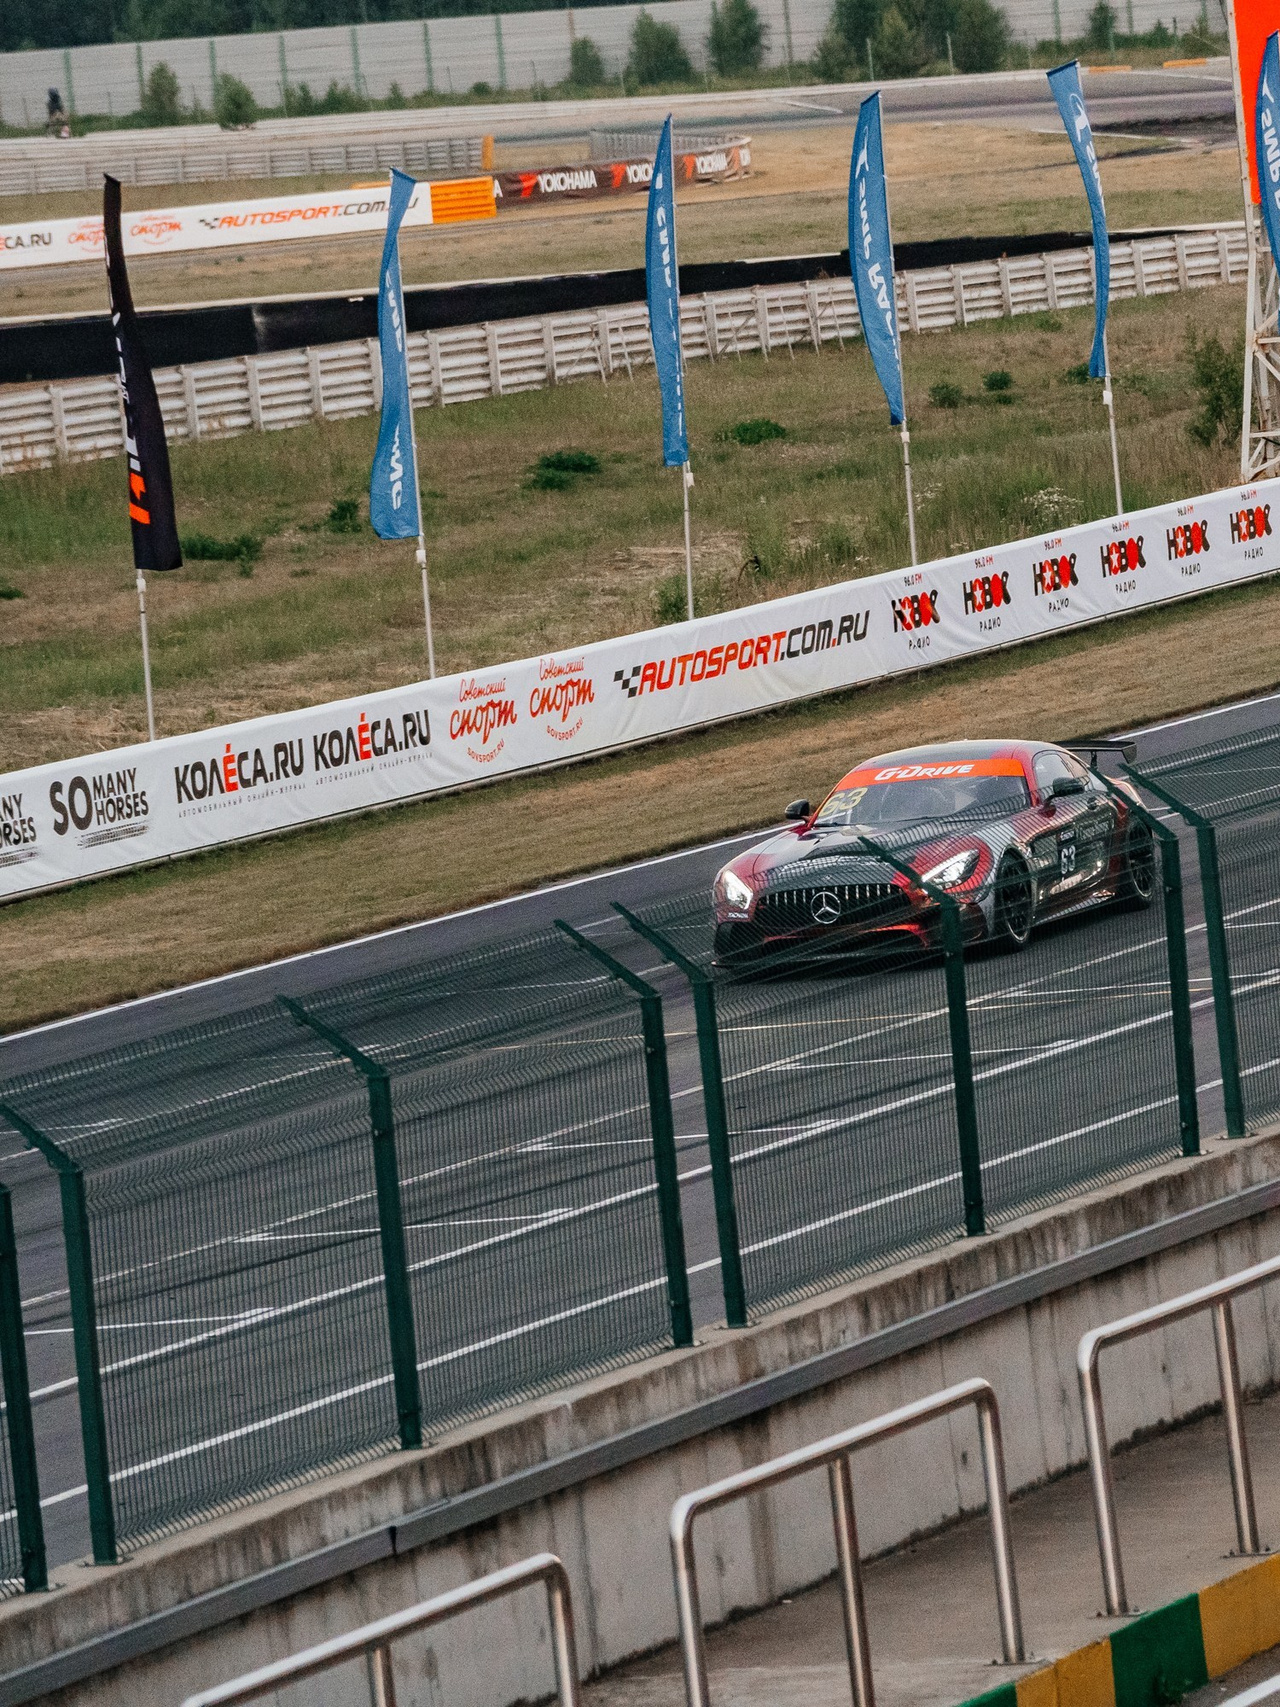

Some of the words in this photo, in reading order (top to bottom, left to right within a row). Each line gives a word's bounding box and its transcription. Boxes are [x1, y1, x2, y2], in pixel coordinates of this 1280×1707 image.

[537, 170, 597, 193] YOKOHAMA
[1245, 547, 1263, 560] РАДИО
[1181, 563, 1200, 575] РАДИО
[1116, 580, 1136, 593] РАДИО
[1049, 598, 1069, 612] РАДИО
[980, 617, 1001, 632] РАДИО
[540, 657, 585, 681] Советский
[459, 677, 506, 702] Советский
[93, 768, 137, 800] MANY
[0, 793, 23, 822] NY
[50, 776, 93, 836] SO
[94, 791, 149, 826] HORSES
[818, 787, 868, 817] 63
[1061, 845, 1076, 875] 63
